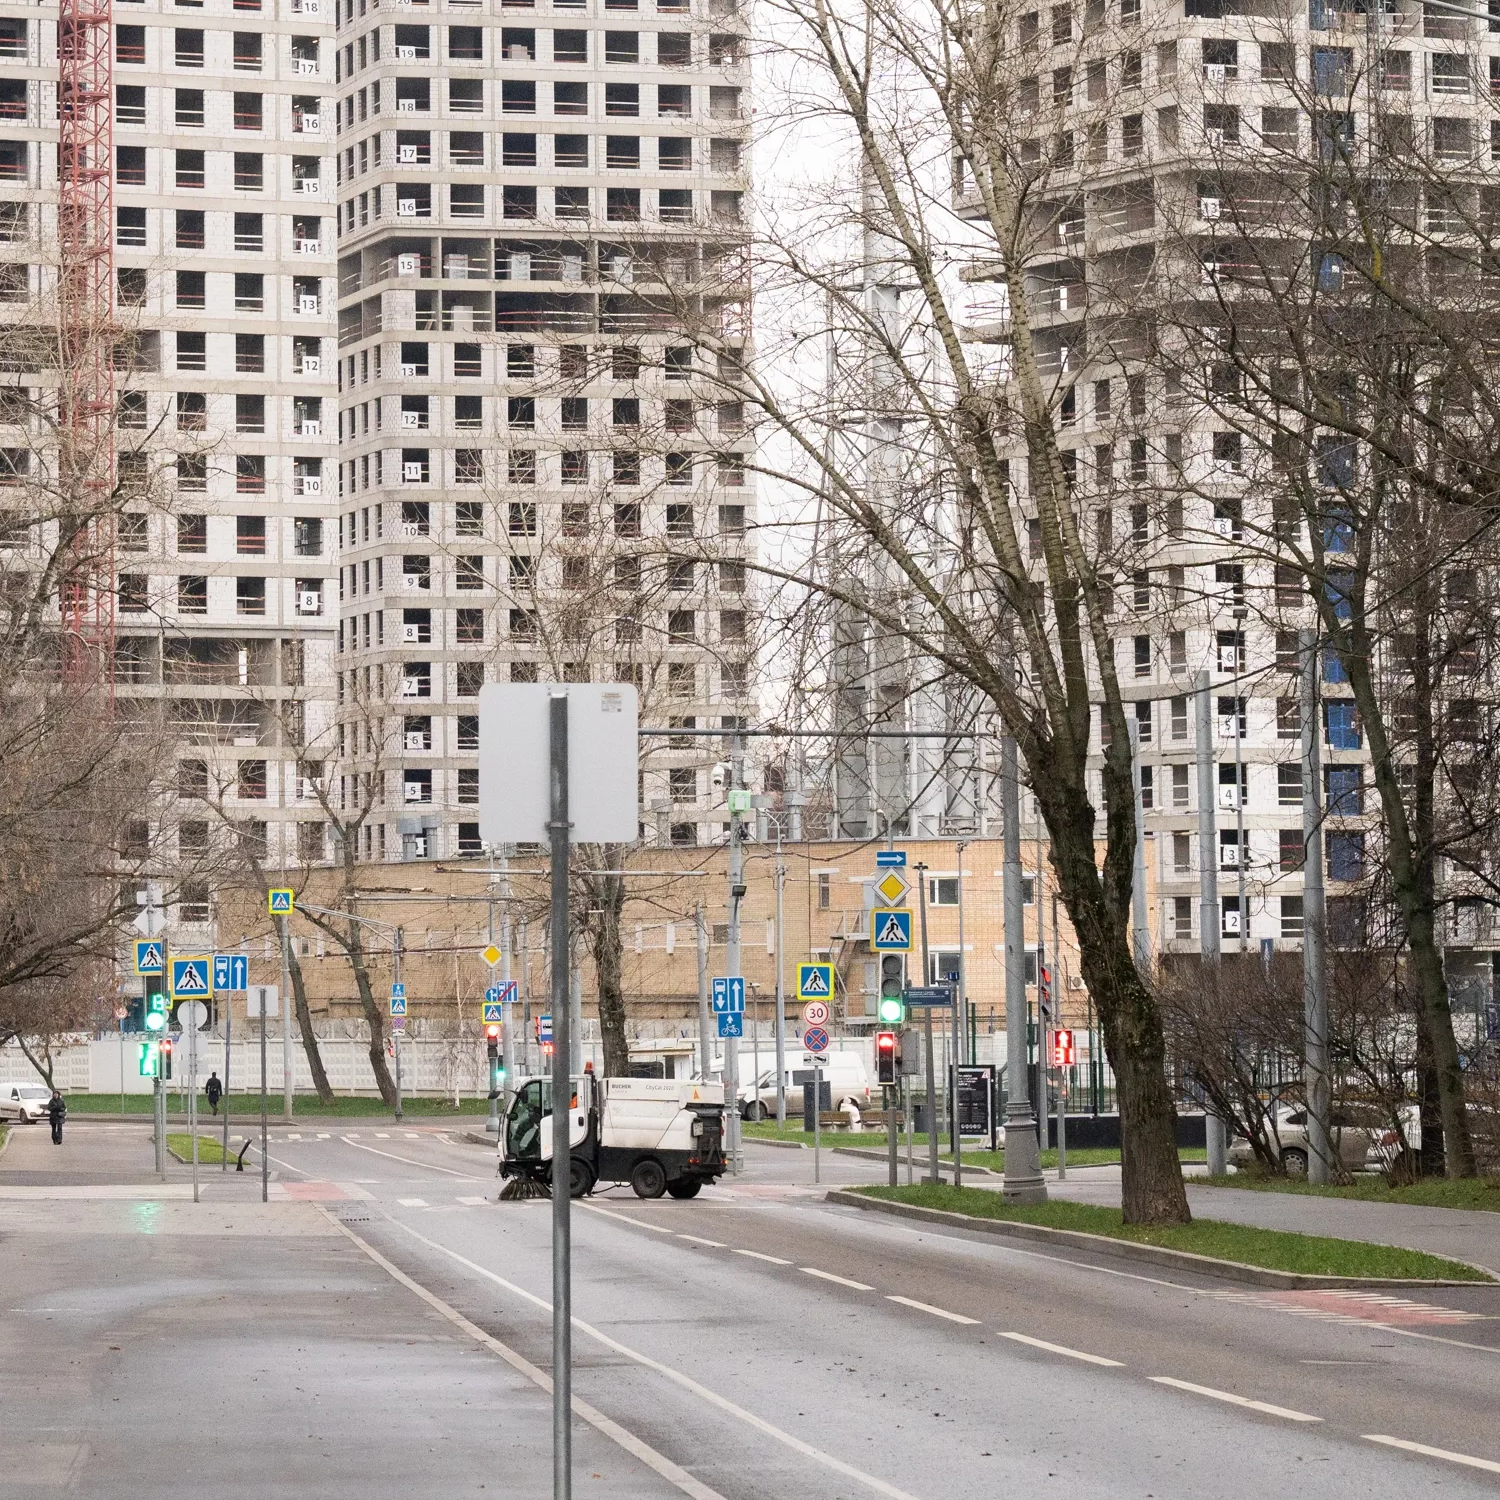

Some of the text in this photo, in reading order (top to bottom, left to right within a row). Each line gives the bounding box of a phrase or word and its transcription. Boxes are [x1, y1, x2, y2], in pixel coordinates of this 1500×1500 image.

[305, 3, 317, 12] 18
[402, 50, 413, 58] 19
[302, 64, 313, 73] 17
[402, 103, 413, 111] 18
[306, 119, 317, 128] 16
[403, 149, 414, 158] 17
[306, 183, 318, 192] 15
[402, 203, 413, 211] 16
[304, 244, 316, 253] 14
[401, 261, 412, 270] 15
[303, 300, 314, 309] 13
[306, 361, 317, 370] 12
[402, 368, 413, 376] 13
[405, 416, 416, 424] 12
[305, 425, 317, 434] 11
[408, 466, 418, 475] 11
[306, 482, 318, 490] 10
[405, 527, 416, 536] 10
[408, 578, 413, 586] 9
[306, 597, 312, 606] 8
[407, 628, 413, 637] 8
[1227, 652, 1233, 661] 6
[407, 681, 412, 689] 7
[412, 736, 418, 744] 6
[411, 786, 415, 794] 5
[1226, 790, 1232, 800] 4
[1229, 850, 1234, 860] 3
[1232, 917, 1237, 926] 2
[809, 1008, 824, 1018] 30
